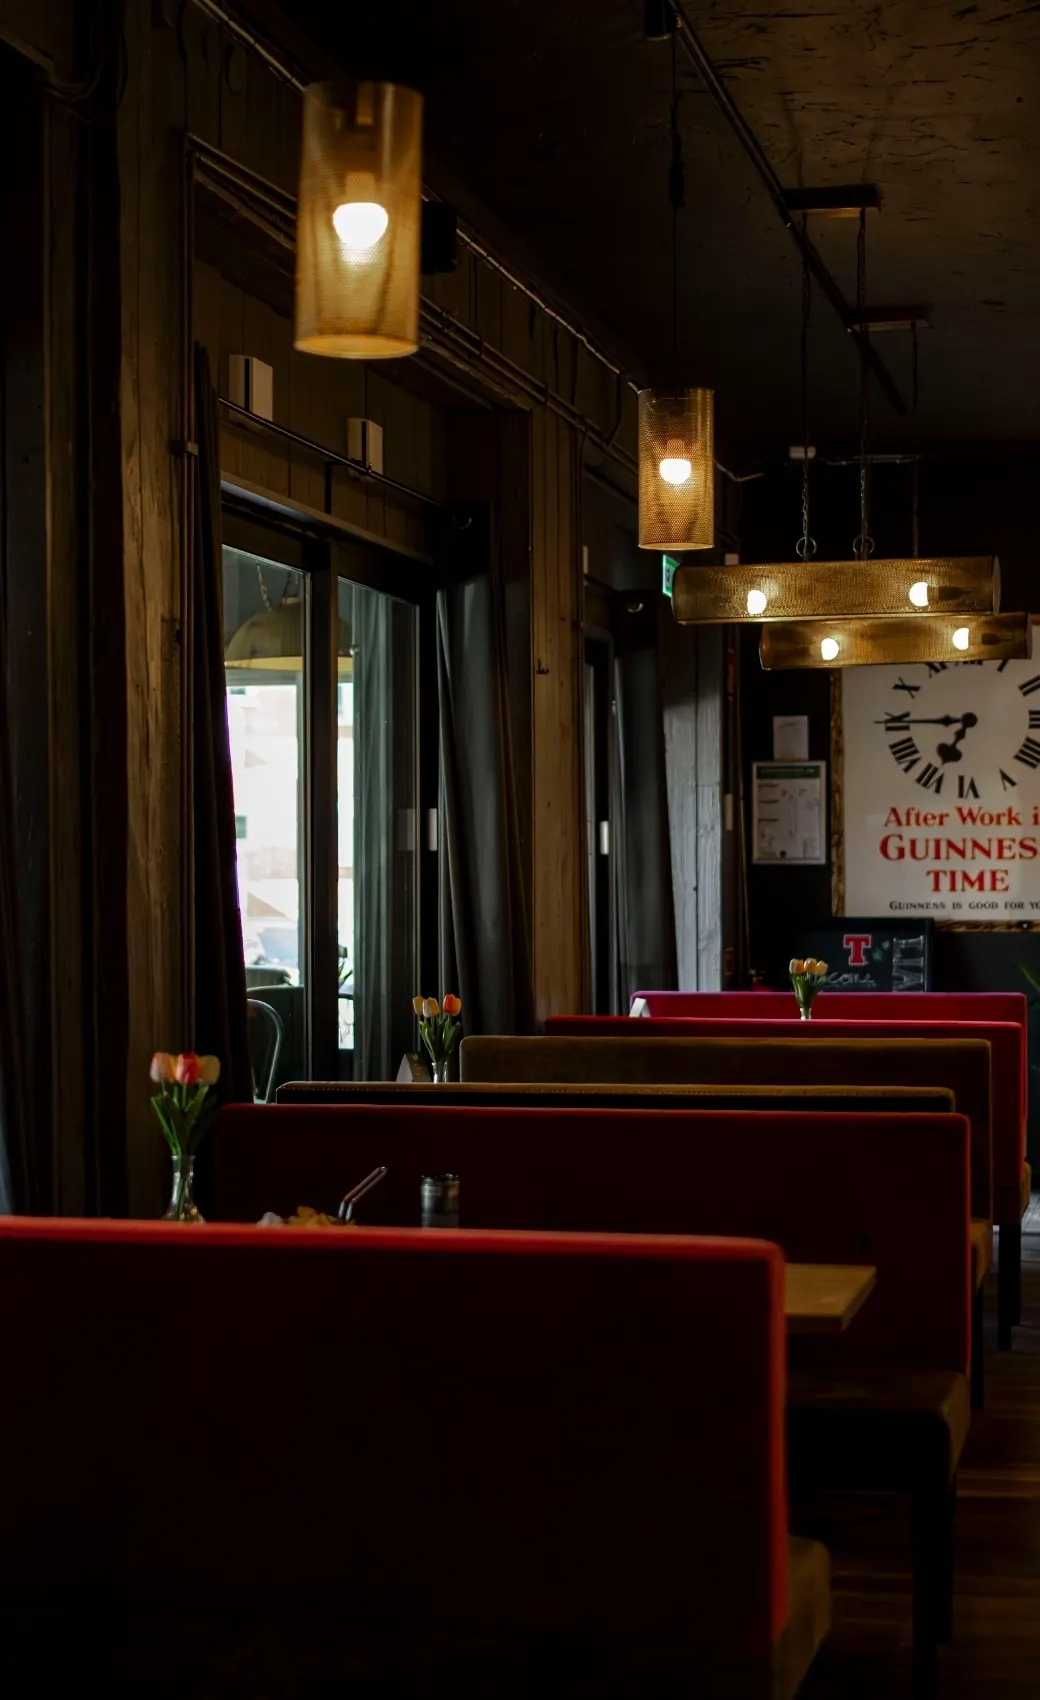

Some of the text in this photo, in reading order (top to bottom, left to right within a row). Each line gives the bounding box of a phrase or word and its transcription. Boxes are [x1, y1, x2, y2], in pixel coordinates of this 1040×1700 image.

[892, 676, 921, 699] X
[957, 775, 980, 799] VI
[884, 806, 1040, 827] After Work i
[879, 834, 1040, 861] GUINNES
[925, 869, 1010, 893] TIME
[889, 900, 1040, 911] GUINNESS IS GOOD FOR YO
[843, 933, 873, 967] T
